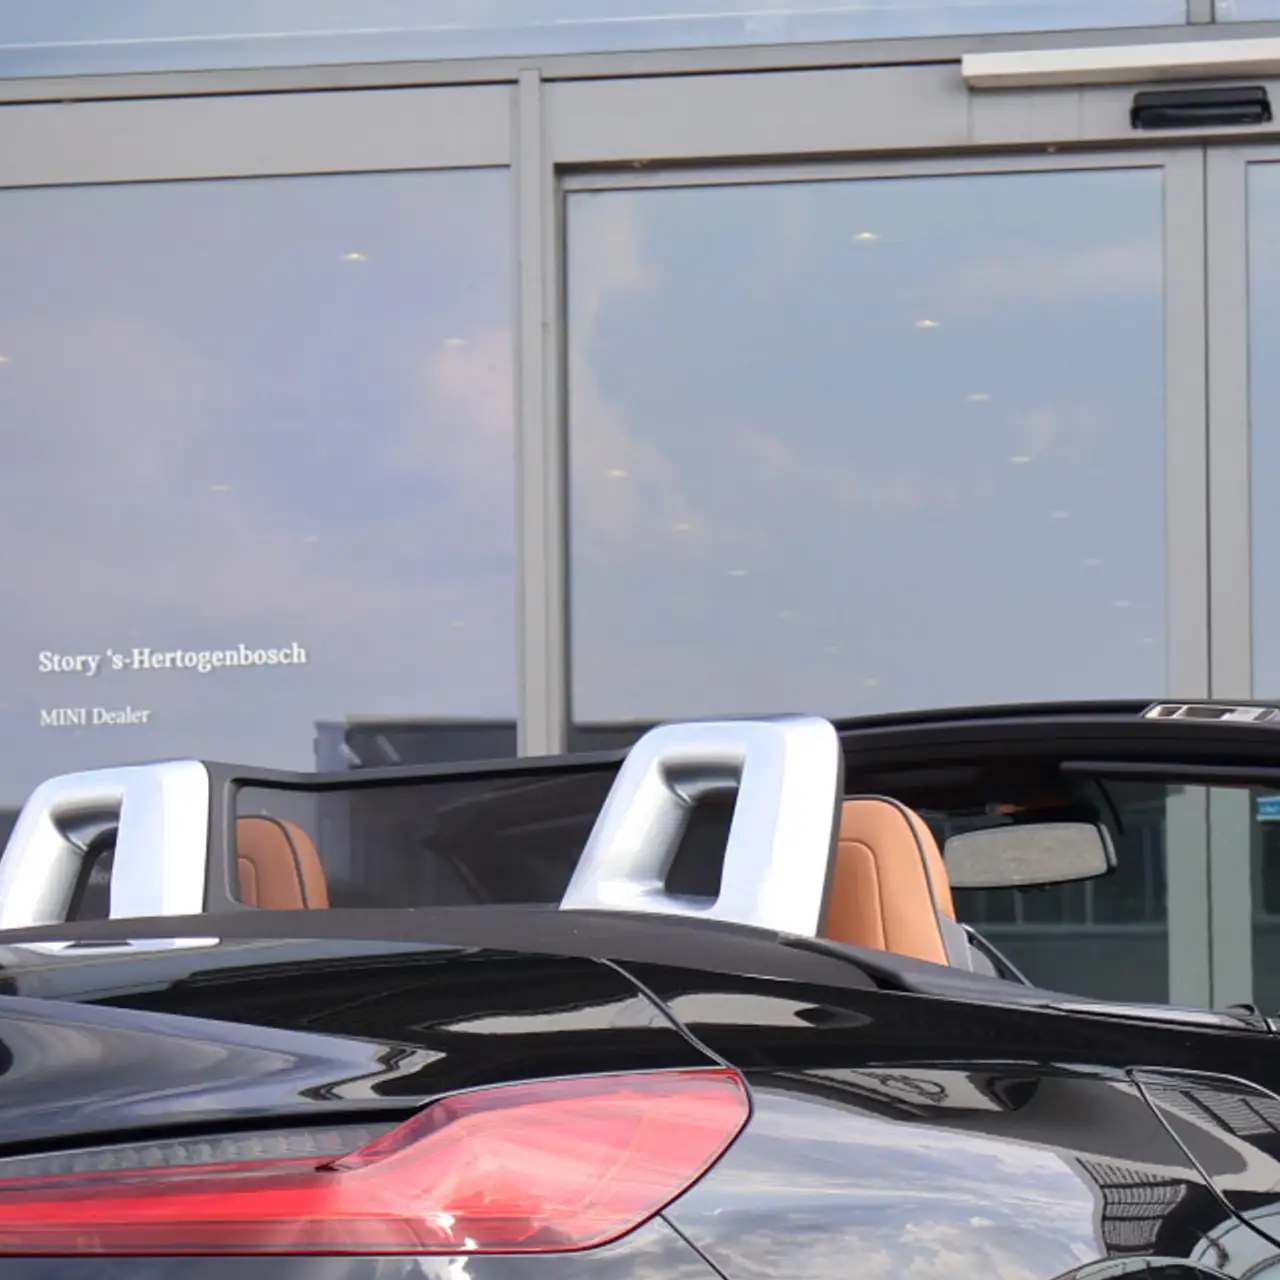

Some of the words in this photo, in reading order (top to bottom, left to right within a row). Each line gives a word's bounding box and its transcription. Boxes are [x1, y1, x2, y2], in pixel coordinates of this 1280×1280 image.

[39, 651, 99, 675] Story
[40, 708, 86, 726] MINI
[92, 706, 150, 724] Dealer
